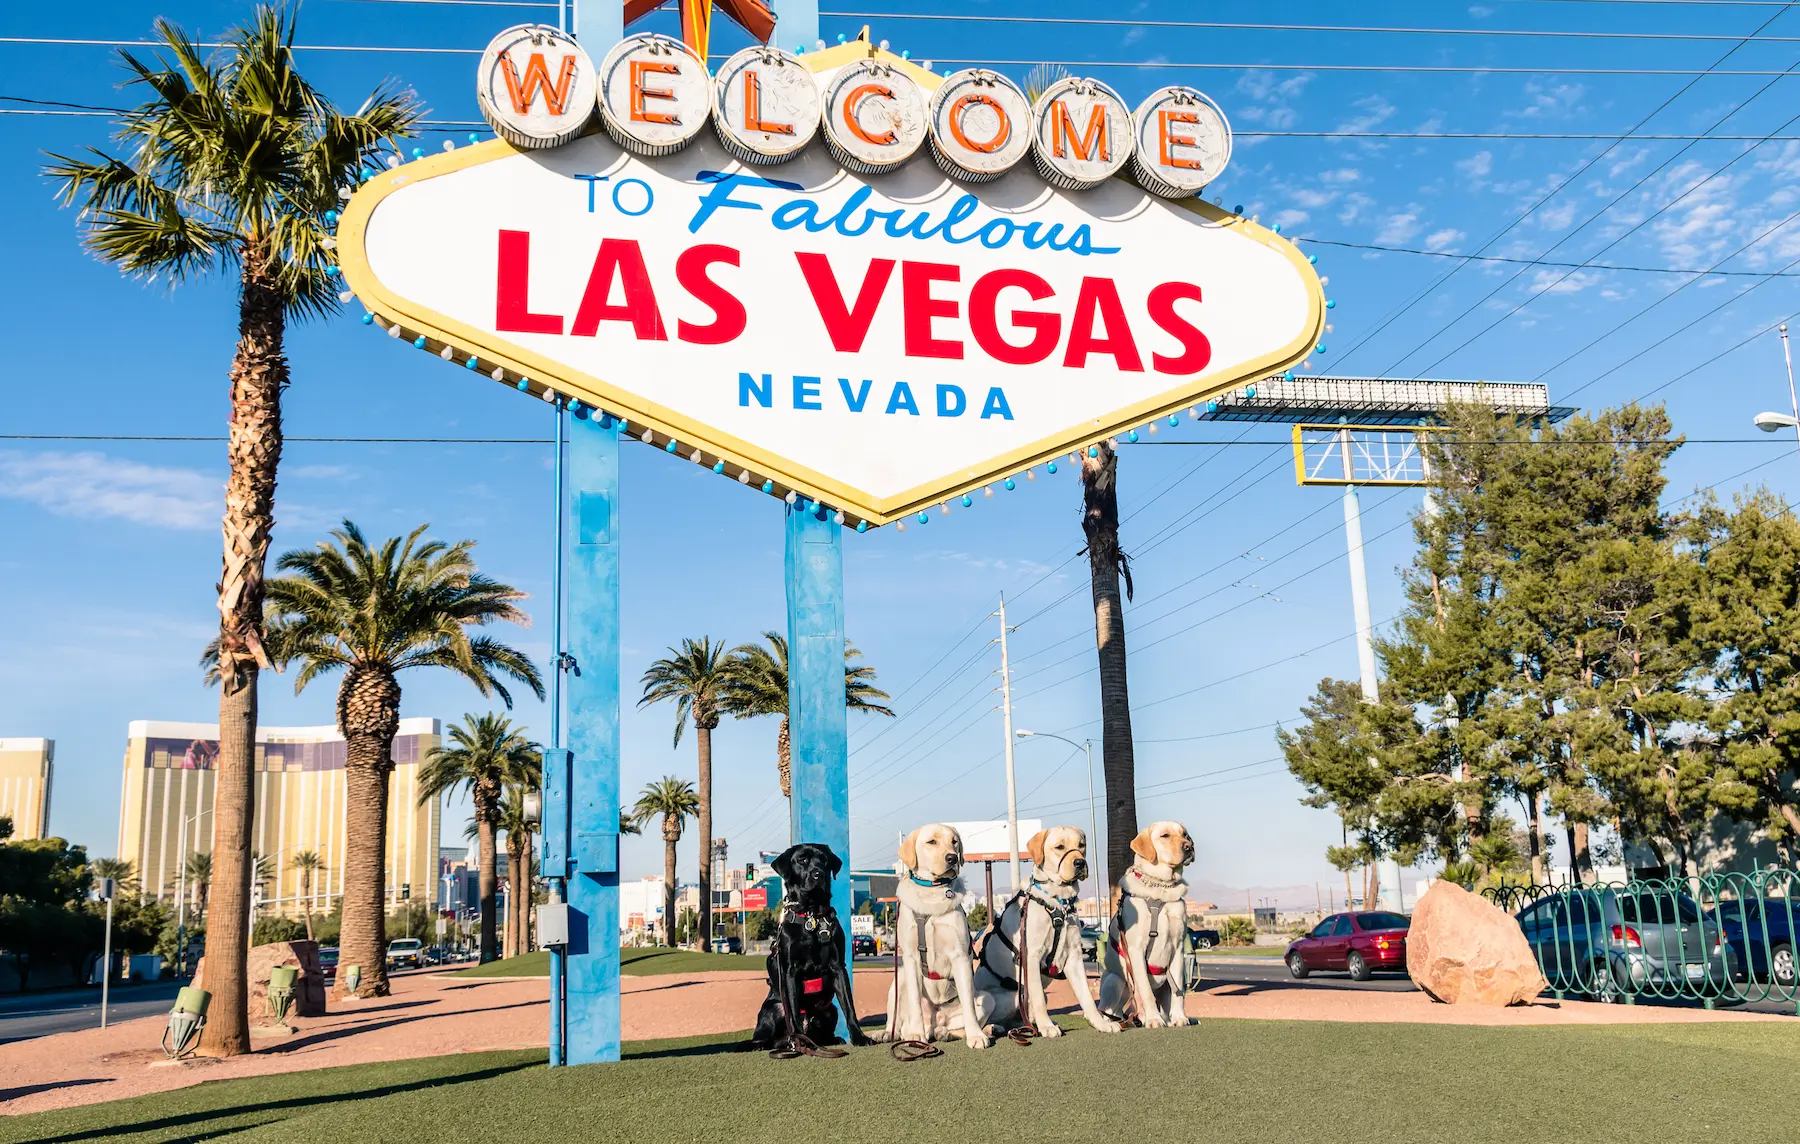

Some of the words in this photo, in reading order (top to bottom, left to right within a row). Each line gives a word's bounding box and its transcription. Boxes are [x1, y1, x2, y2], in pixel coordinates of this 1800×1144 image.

[498, 50, 1202, 170] WELCOME
[574, 174, 654, 217] TO
[688, 170, 1120, 255] Fabulous
[496, 230, 747, 345] LAS
[795, 252, 1212, 376] VEGAS
[739, 373, 1015, 419] NEVADA
